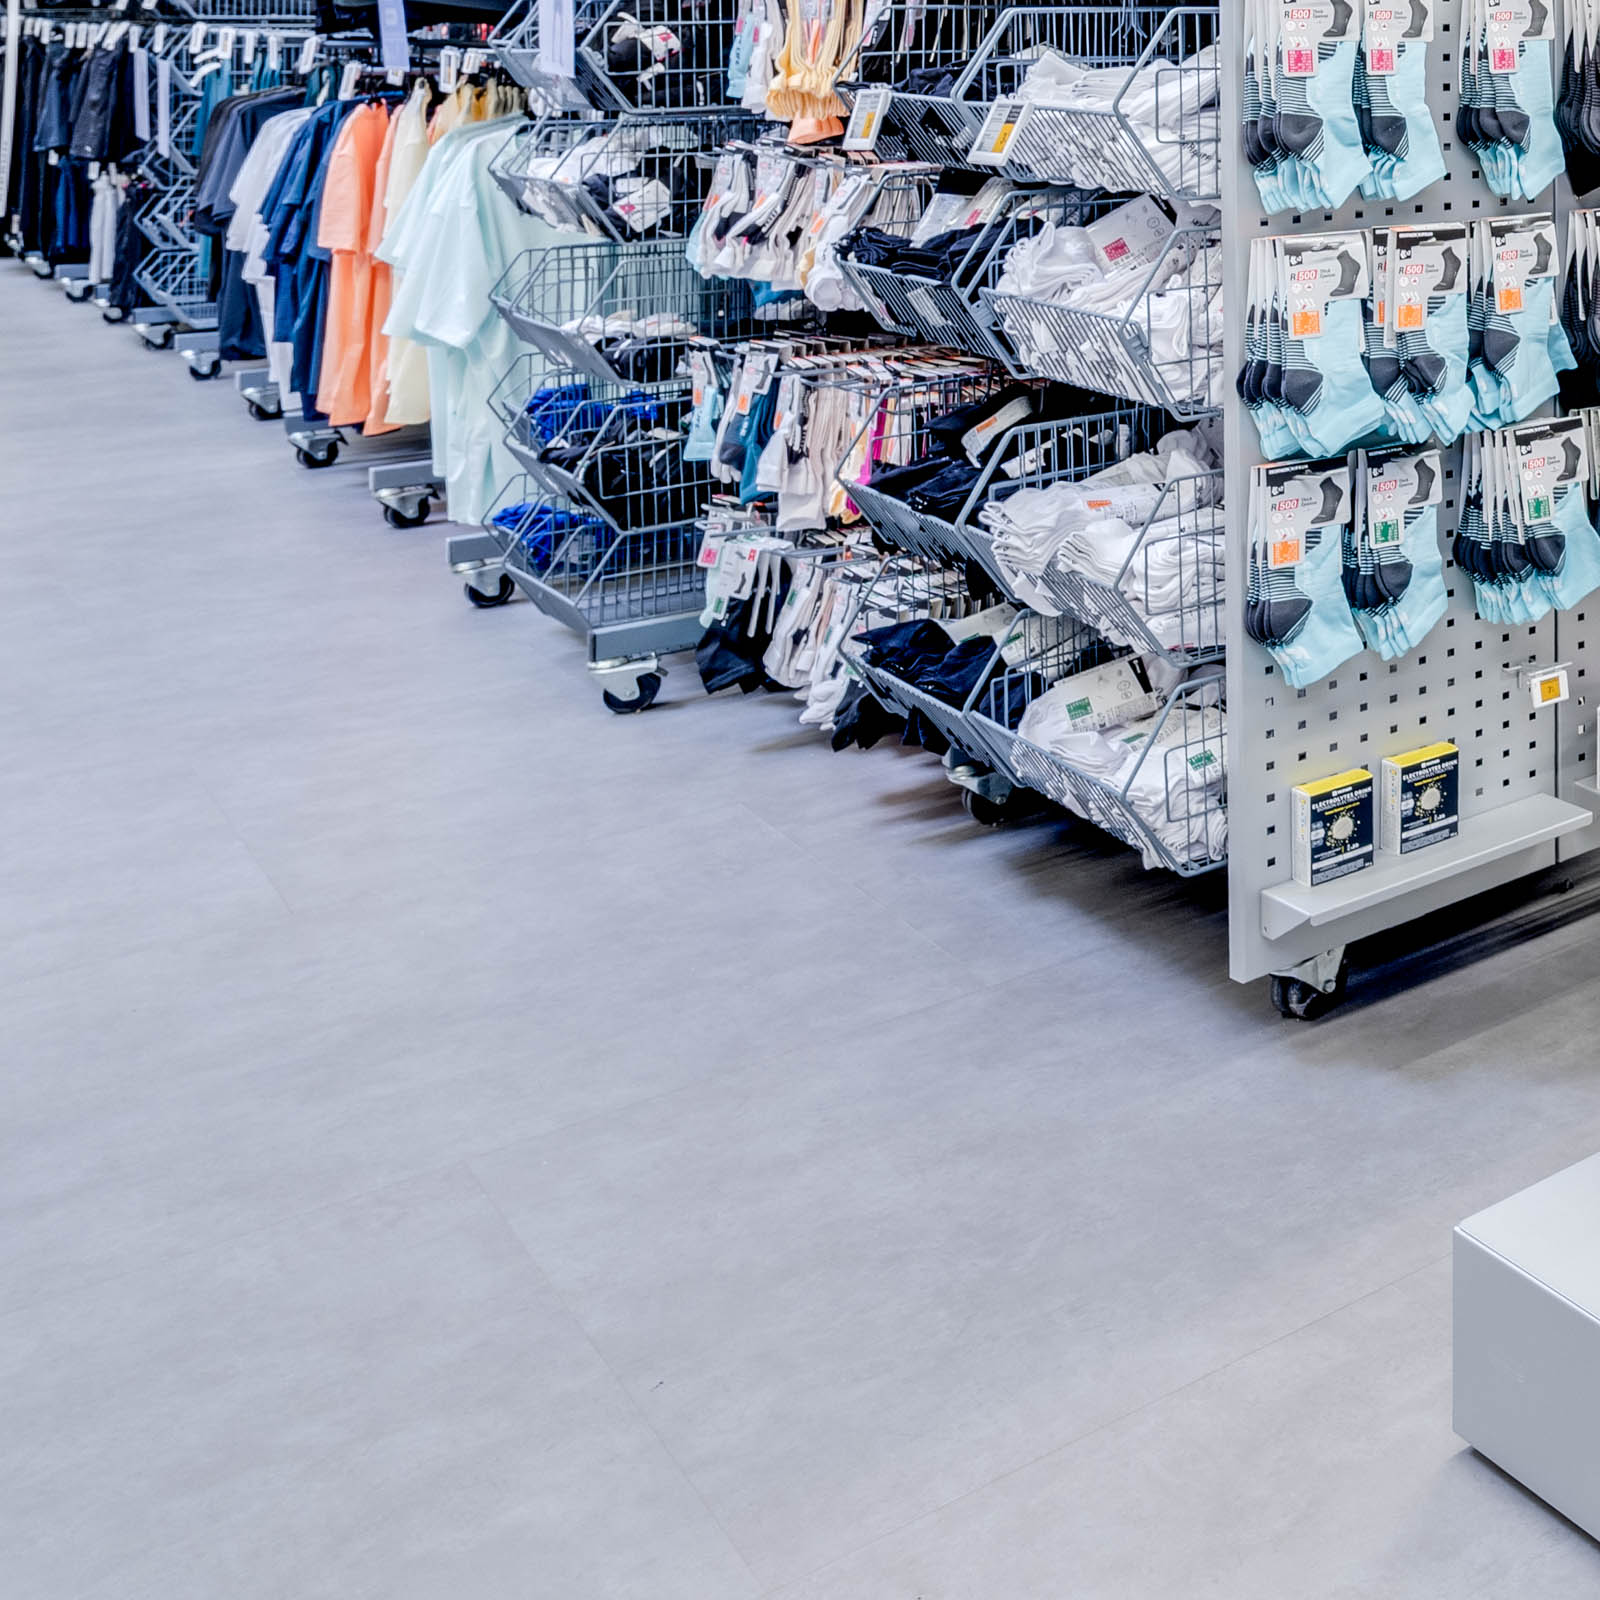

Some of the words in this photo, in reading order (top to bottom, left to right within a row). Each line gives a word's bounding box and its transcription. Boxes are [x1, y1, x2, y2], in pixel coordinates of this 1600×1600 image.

[1278, 500, 1298, 511] 500
[1402, 764, 1442, 781] ELECTROLYTES
[1312, 792, 1354, 811] ELECTROLYTES
